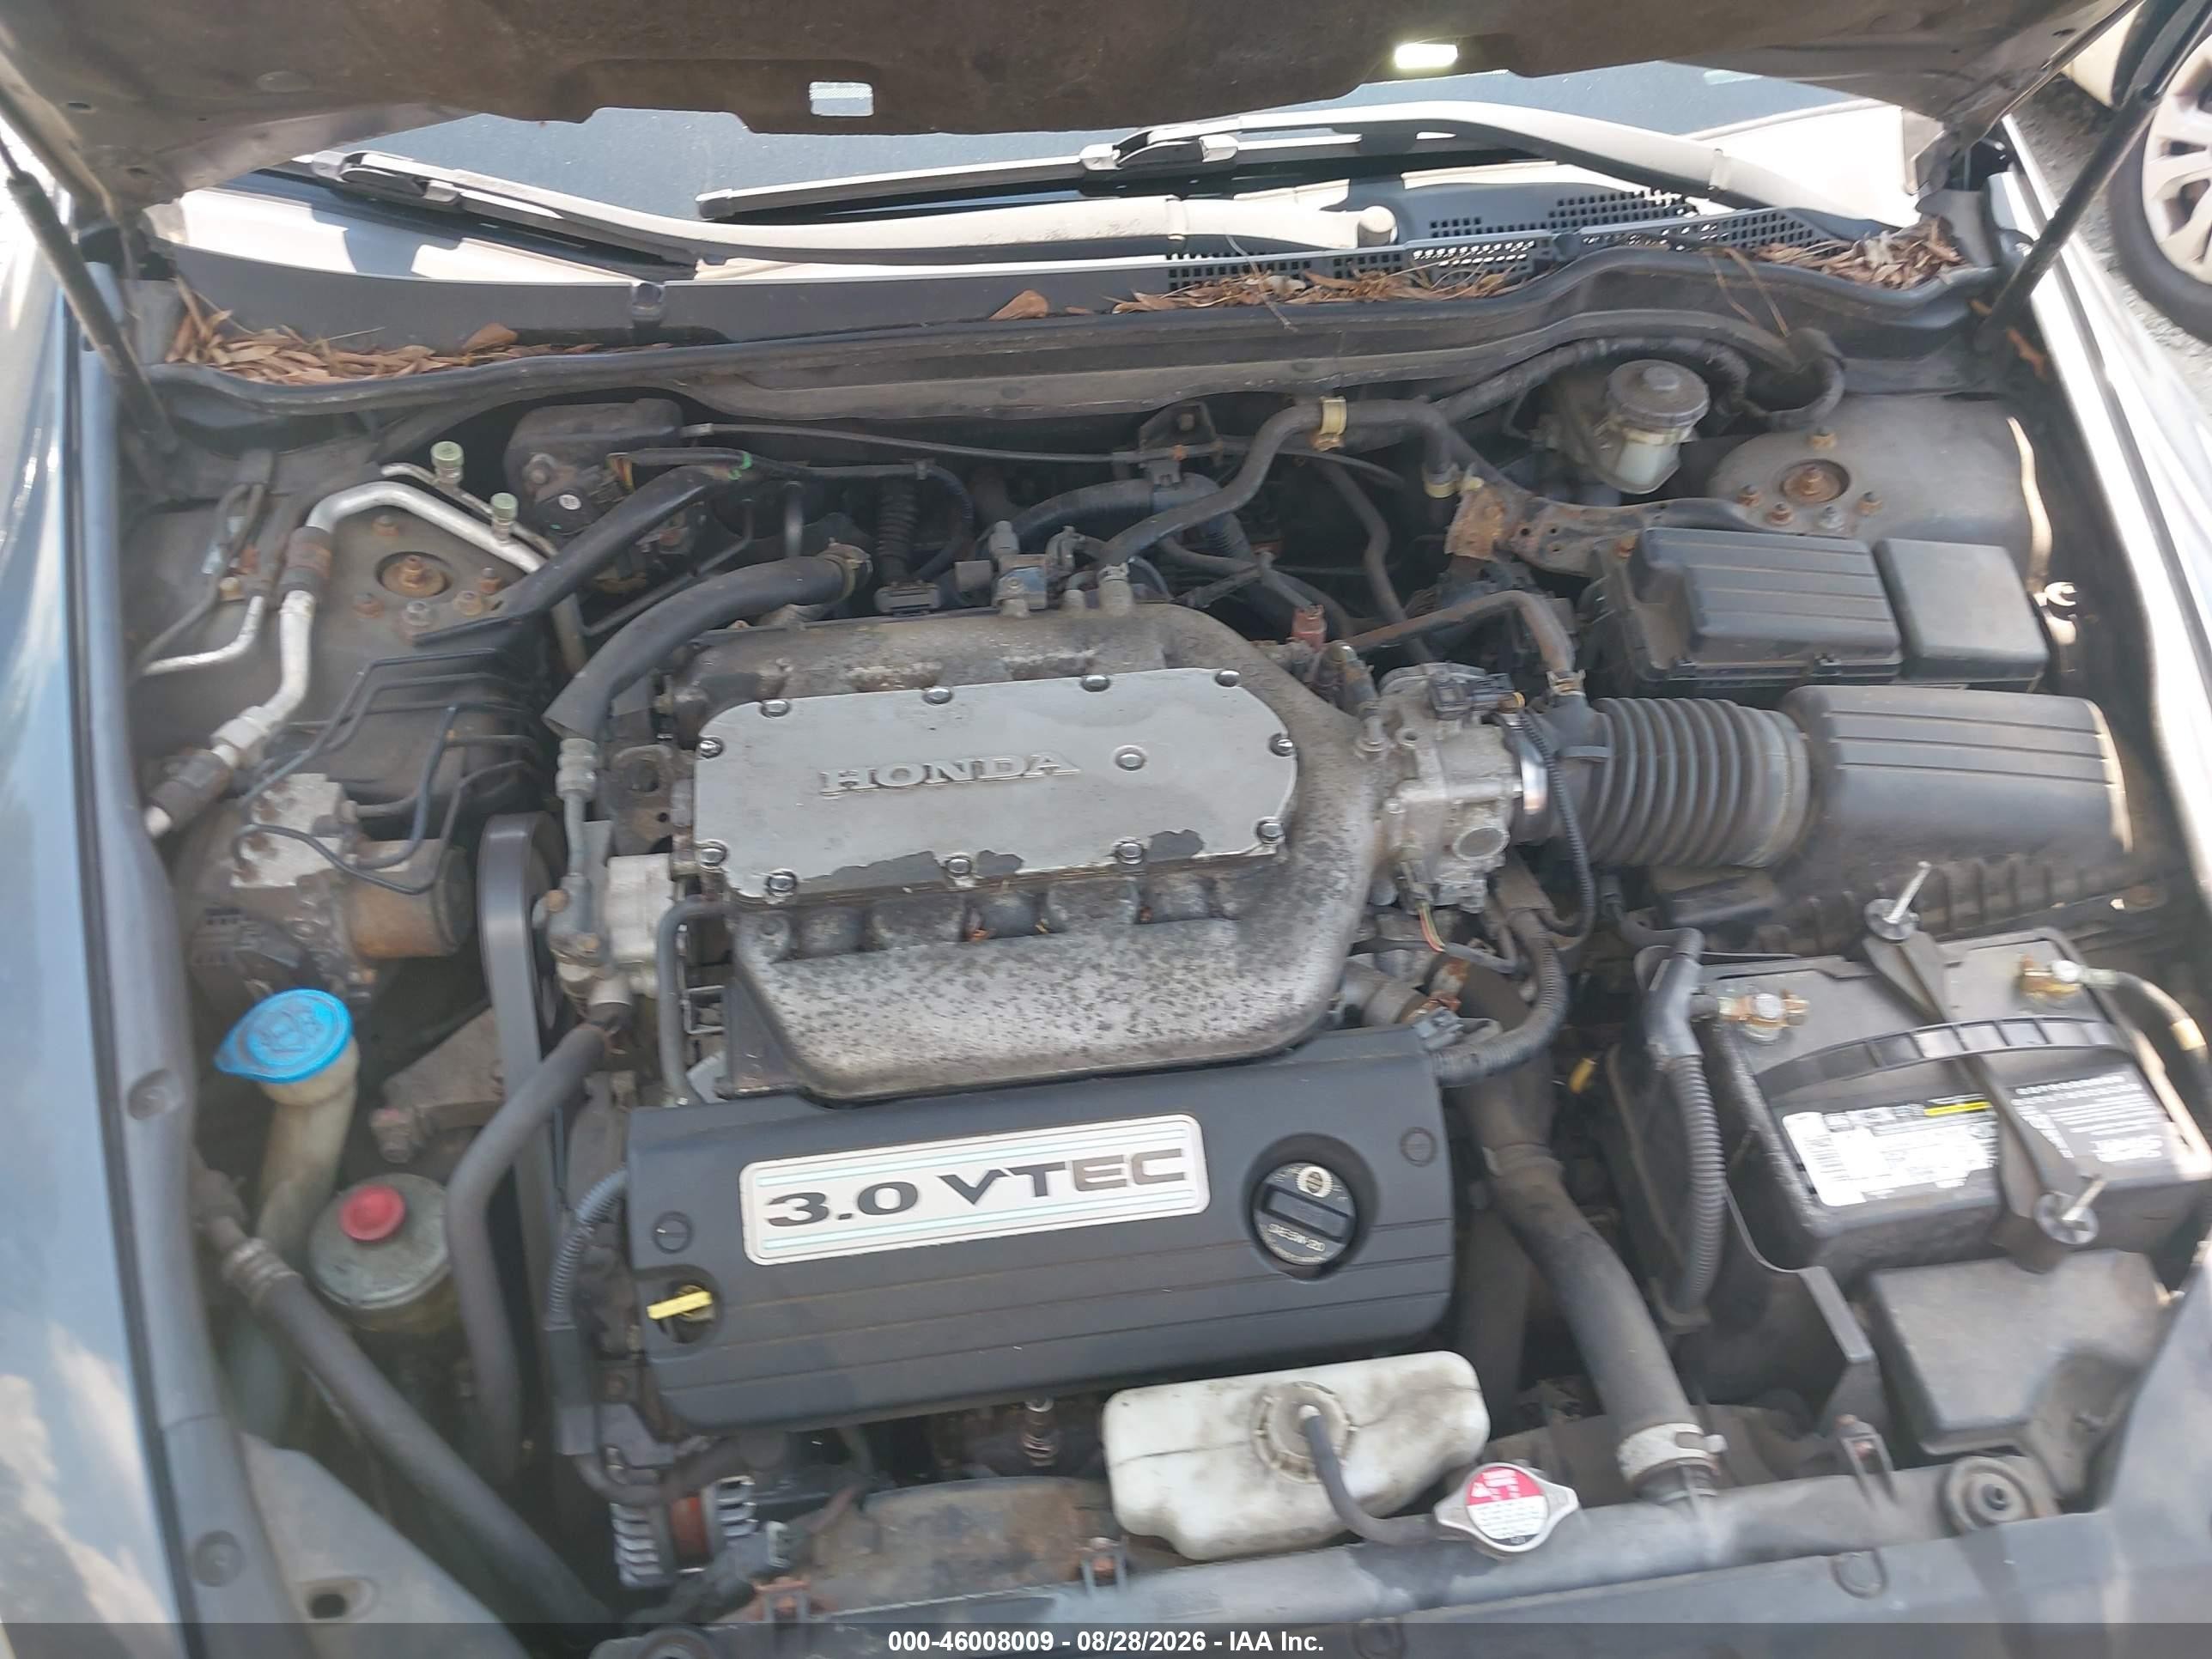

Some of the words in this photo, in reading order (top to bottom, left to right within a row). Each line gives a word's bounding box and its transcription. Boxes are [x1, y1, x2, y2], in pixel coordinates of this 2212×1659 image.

[819, 751, 1081, 797] HONDA
[768, 1181, 919, 1227] 3.0
[936, 1148, 1186, 1206] VTEC
